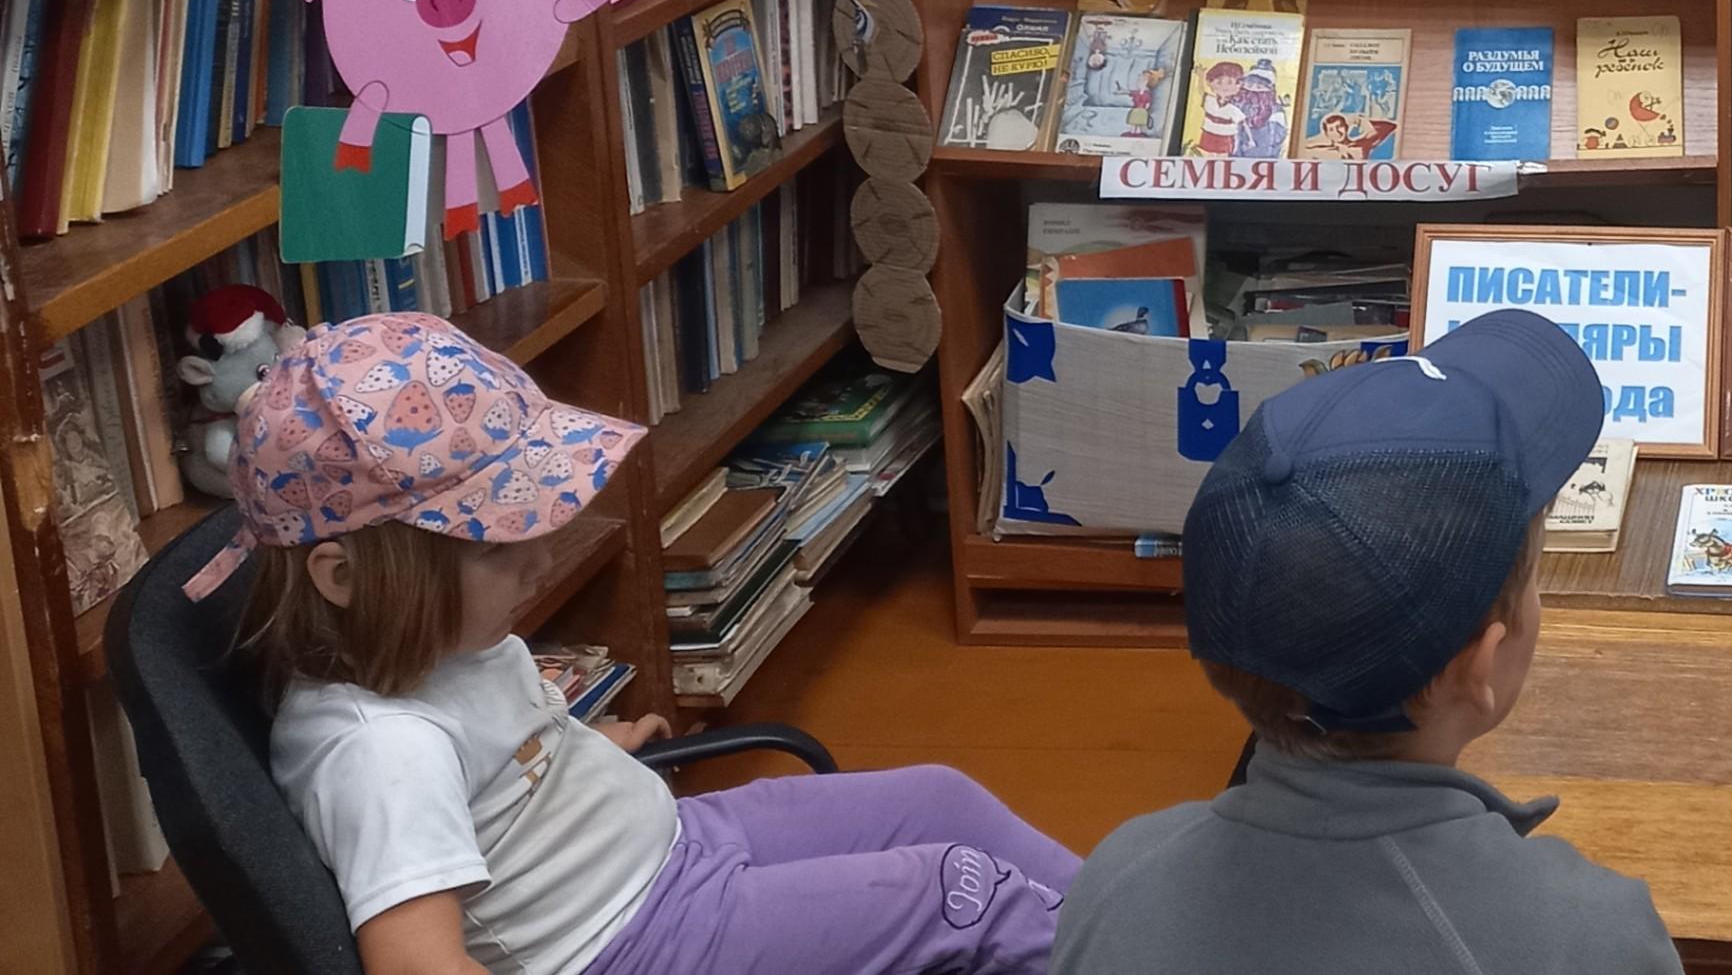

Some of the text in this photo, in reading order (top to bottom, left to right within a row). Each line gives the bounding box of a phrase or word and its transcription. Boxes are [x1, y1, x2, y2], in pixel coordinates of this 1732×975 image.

[1467, 48, 1540, 63] РАЗДУМЬЯ
[1599, 36, 1660, 60] Наш
[1462, 60, 1545, 74] О БУДУЩЕМ
[1119, 159, 1500, 197] СЕМЬЯ И ДОСУГ
[1447, 266, 1687, 308] ПИСАТЕЛИ-
[948, 846, 982, 917] Join
